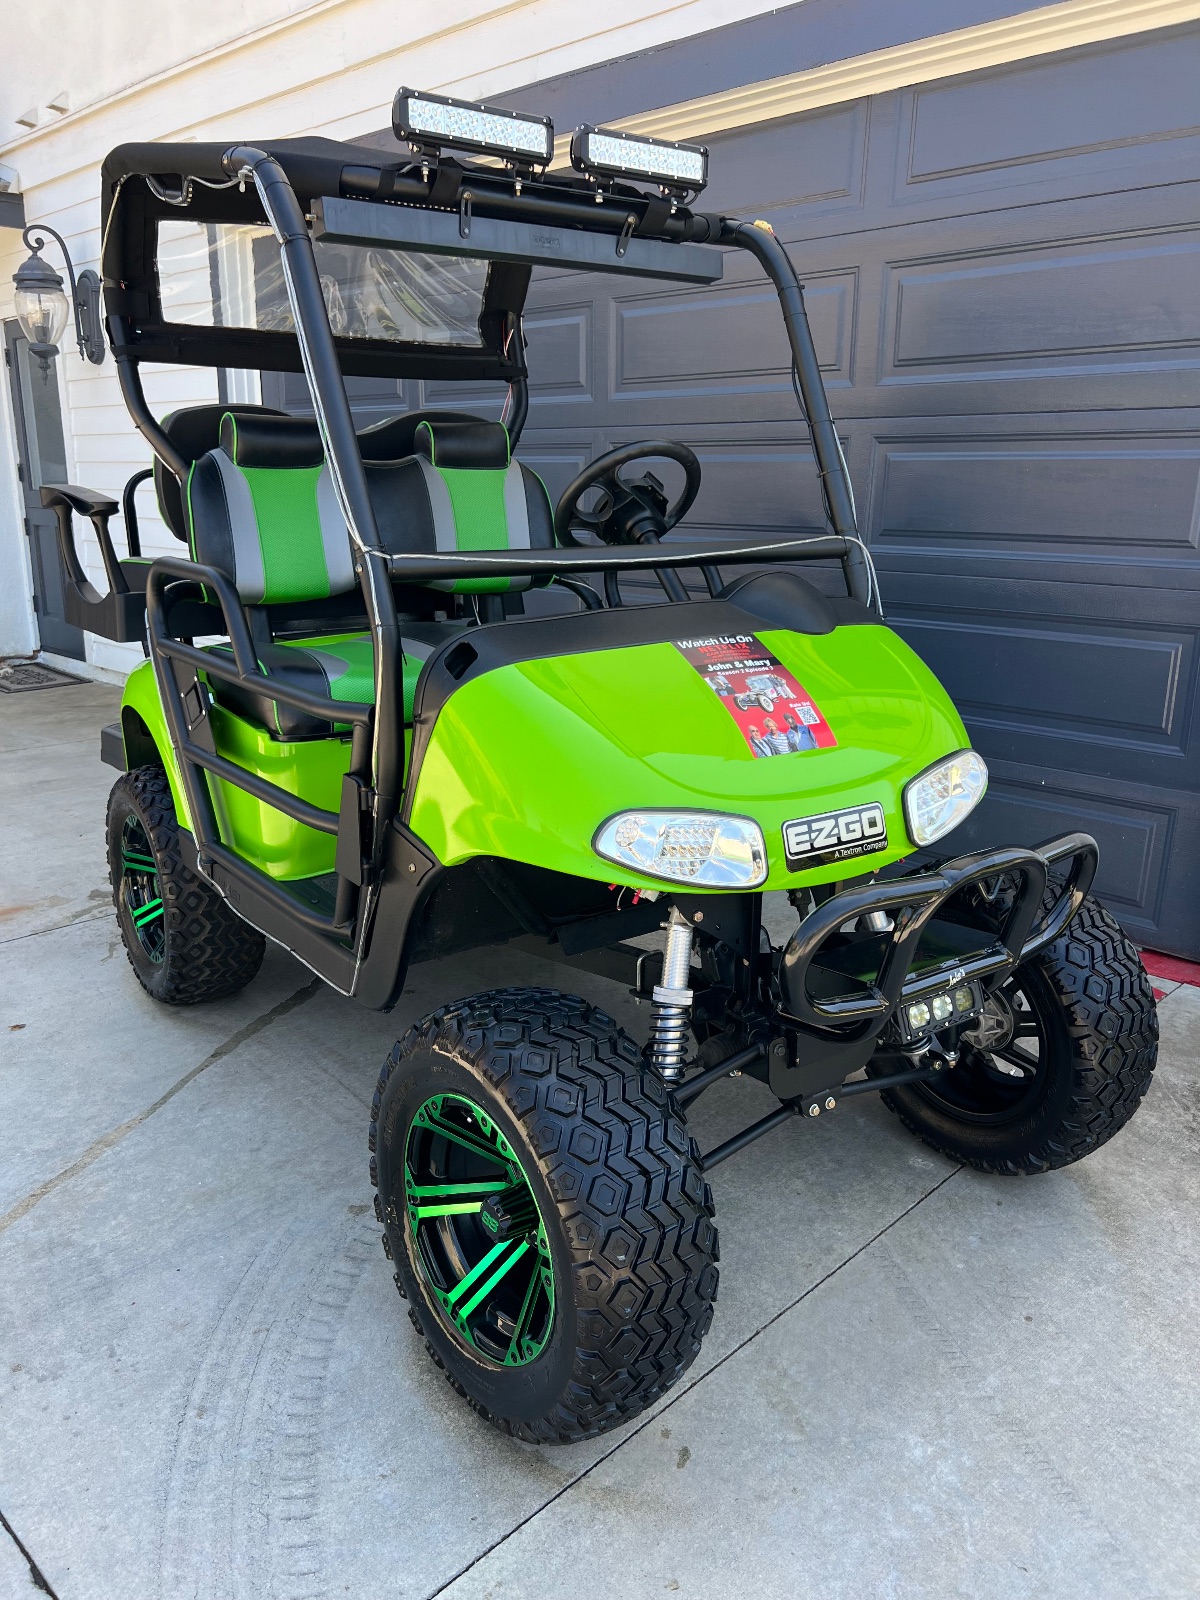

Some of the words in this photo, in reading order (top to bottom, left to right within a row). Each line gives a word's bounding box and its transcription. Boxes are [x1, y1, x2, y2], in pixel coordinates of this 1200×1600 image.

[677, 638, 719, 649] Watch
[719, 636, 735, 645] Us
[735, 635, 754, 643] On
[697, 643, 750, 653] NETFLIX
[707, 663, 733, 671] John
[734, 660, 744, 668] &
[744, 659, 771, 667] Mary
[834, 850, 841, 859] A
[841, 846, 862, 857] Textron
[863, 840, 888, 852] Company
